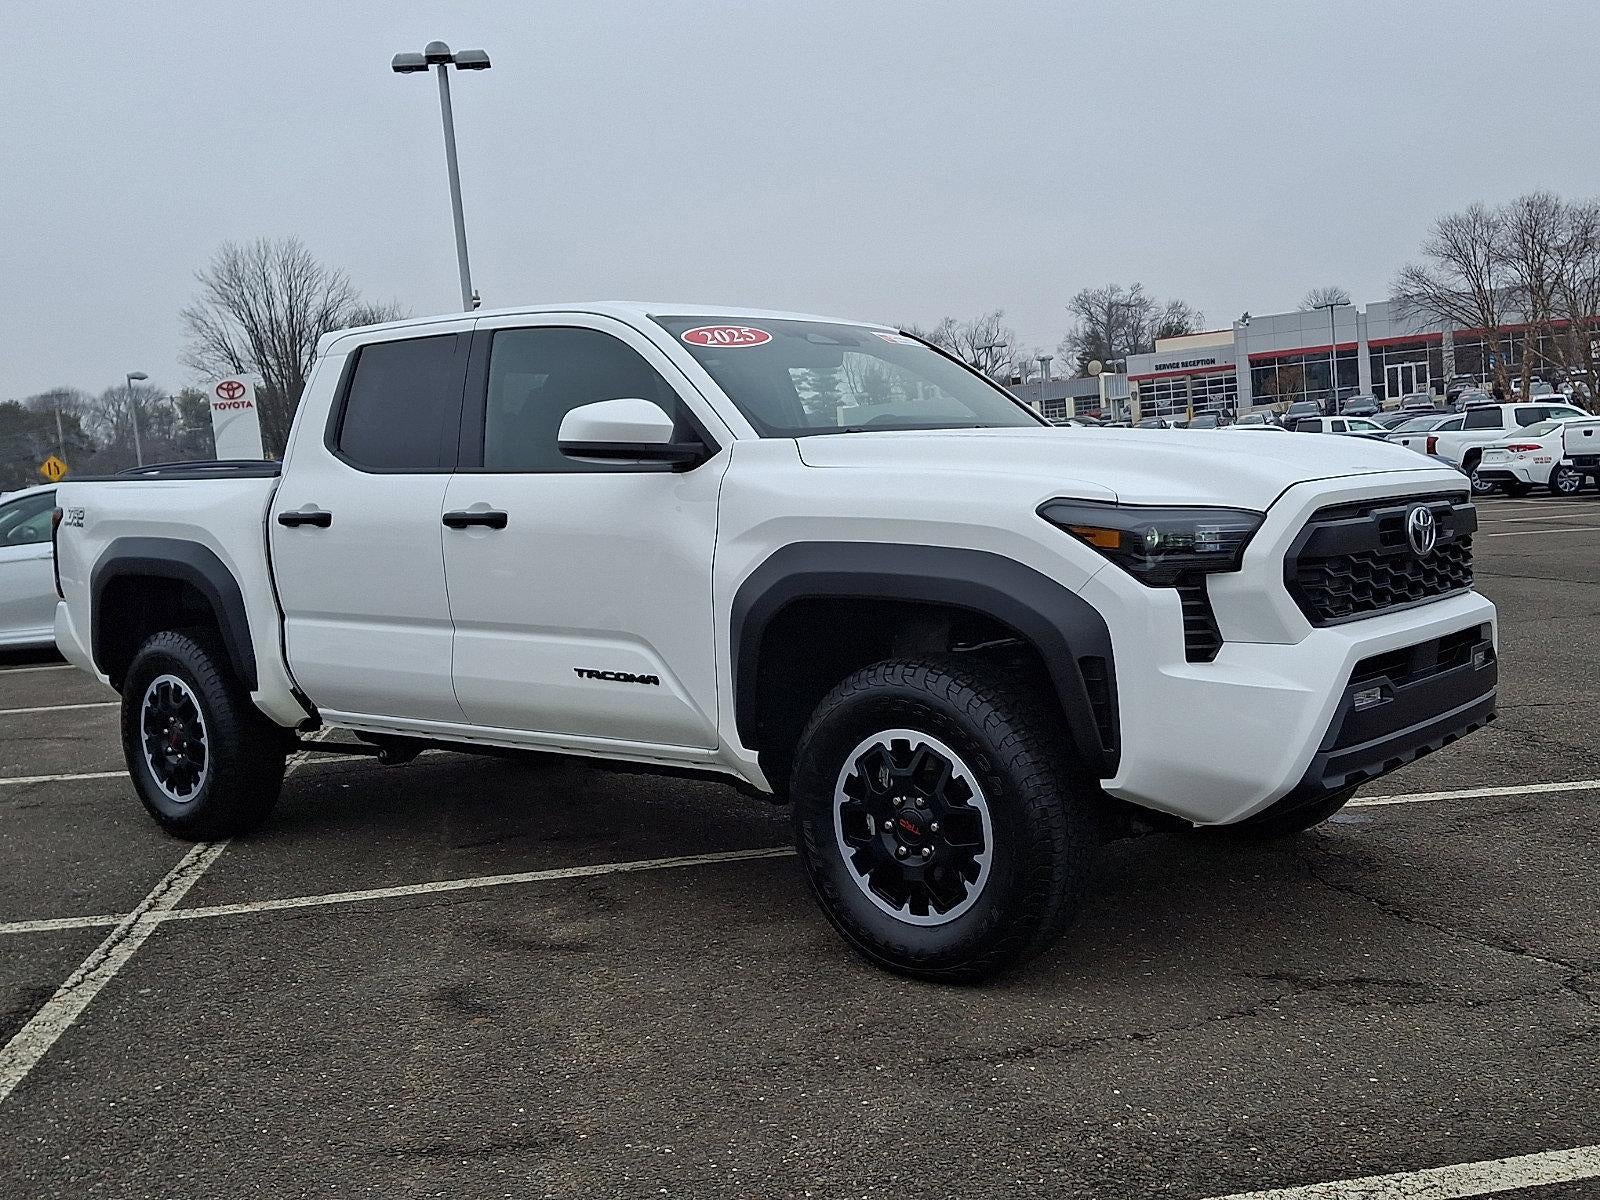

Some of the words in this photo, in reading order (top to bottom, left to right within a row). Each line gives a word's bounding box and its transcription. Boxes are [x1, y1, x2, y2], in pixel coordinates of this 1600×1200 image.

[698, 328, 756, 344] 2025
[1154, 362, 1180, 371] SERVICE
[1181, 358, 1216, 368] RECEPTION
[212, 400, 253, 410] TOYOTA
[573, 667, 660, 686] TACOMA
